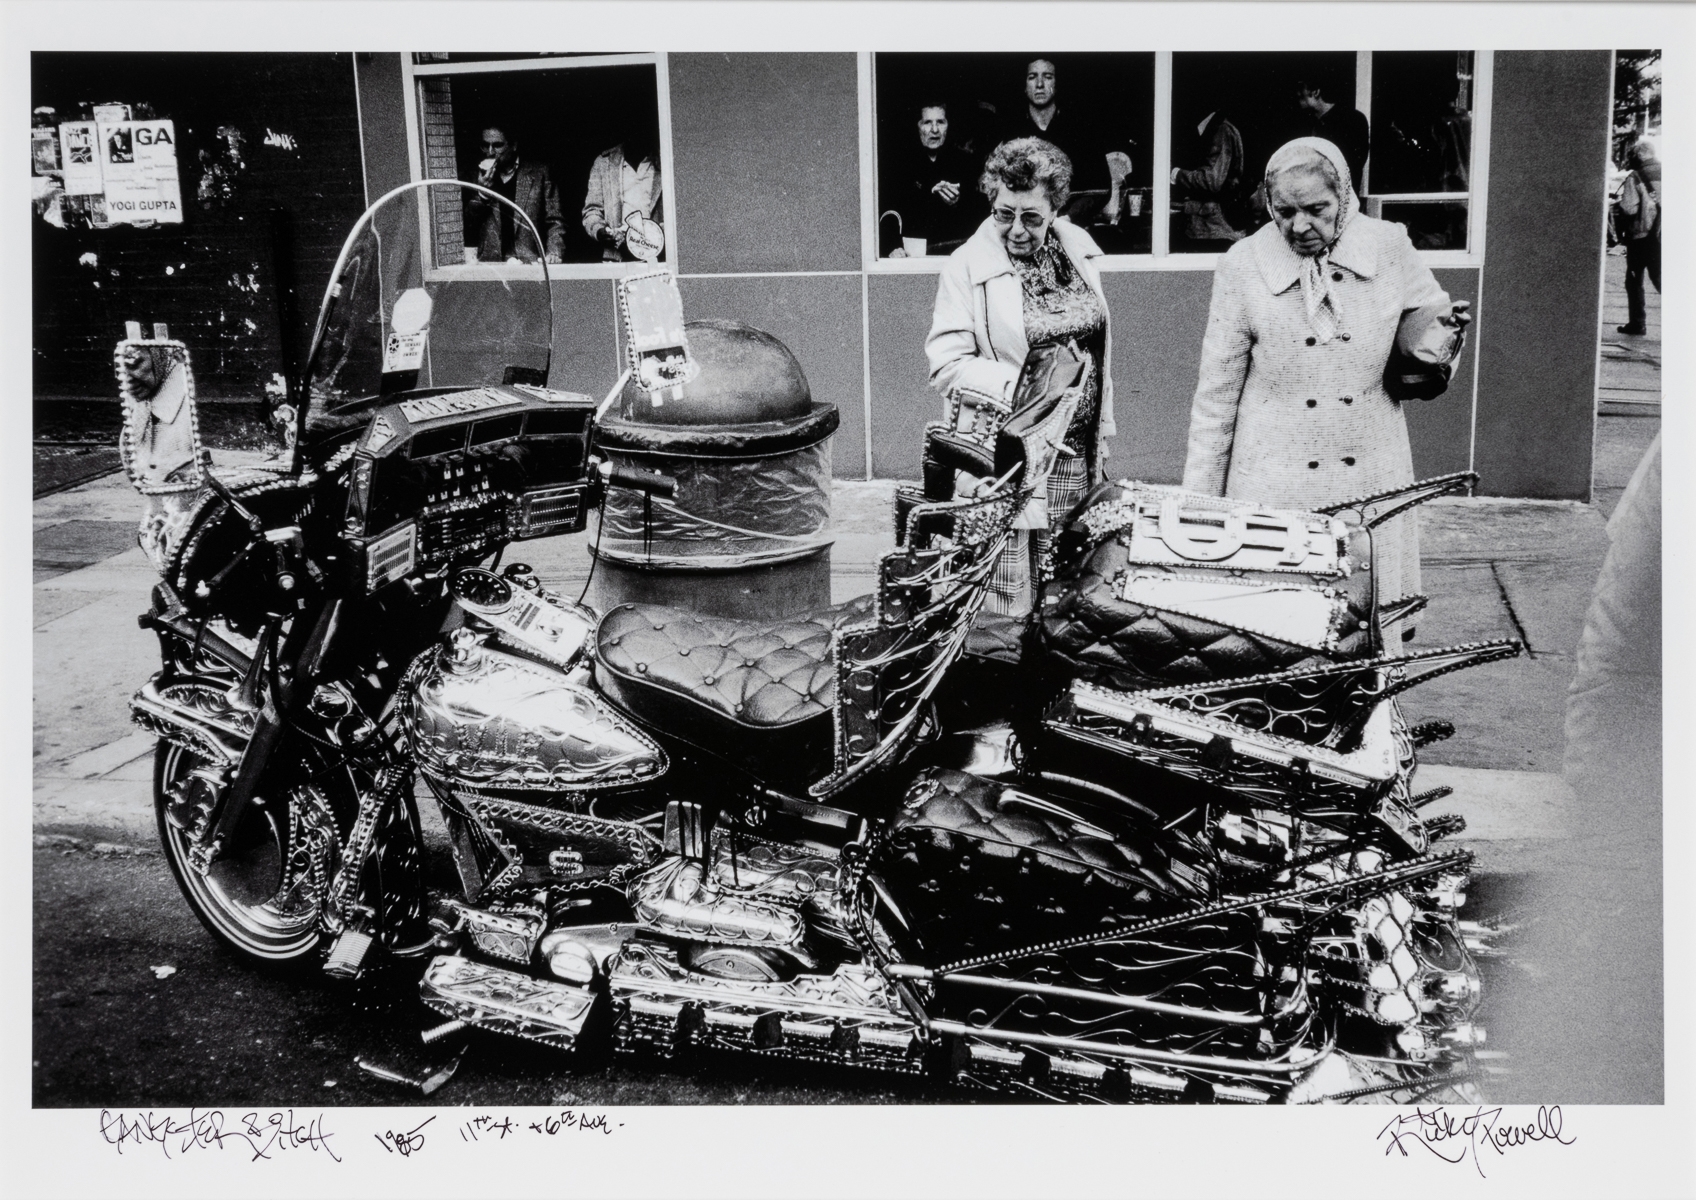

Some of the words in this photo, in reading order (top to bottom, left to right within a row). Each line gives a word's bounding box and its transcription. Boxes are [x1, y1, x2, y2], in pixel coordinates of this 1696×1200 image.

[135, 127, 173, 145] GA
[110, 201, 136, 211] YOGI
[139, 201, 177, 211] GUPTA
[374, 1115, 437, 1157] 1985
[1377, 1106, 1486, 1178] Ricky
[1466, 1105, 1577, 1155] Powell
